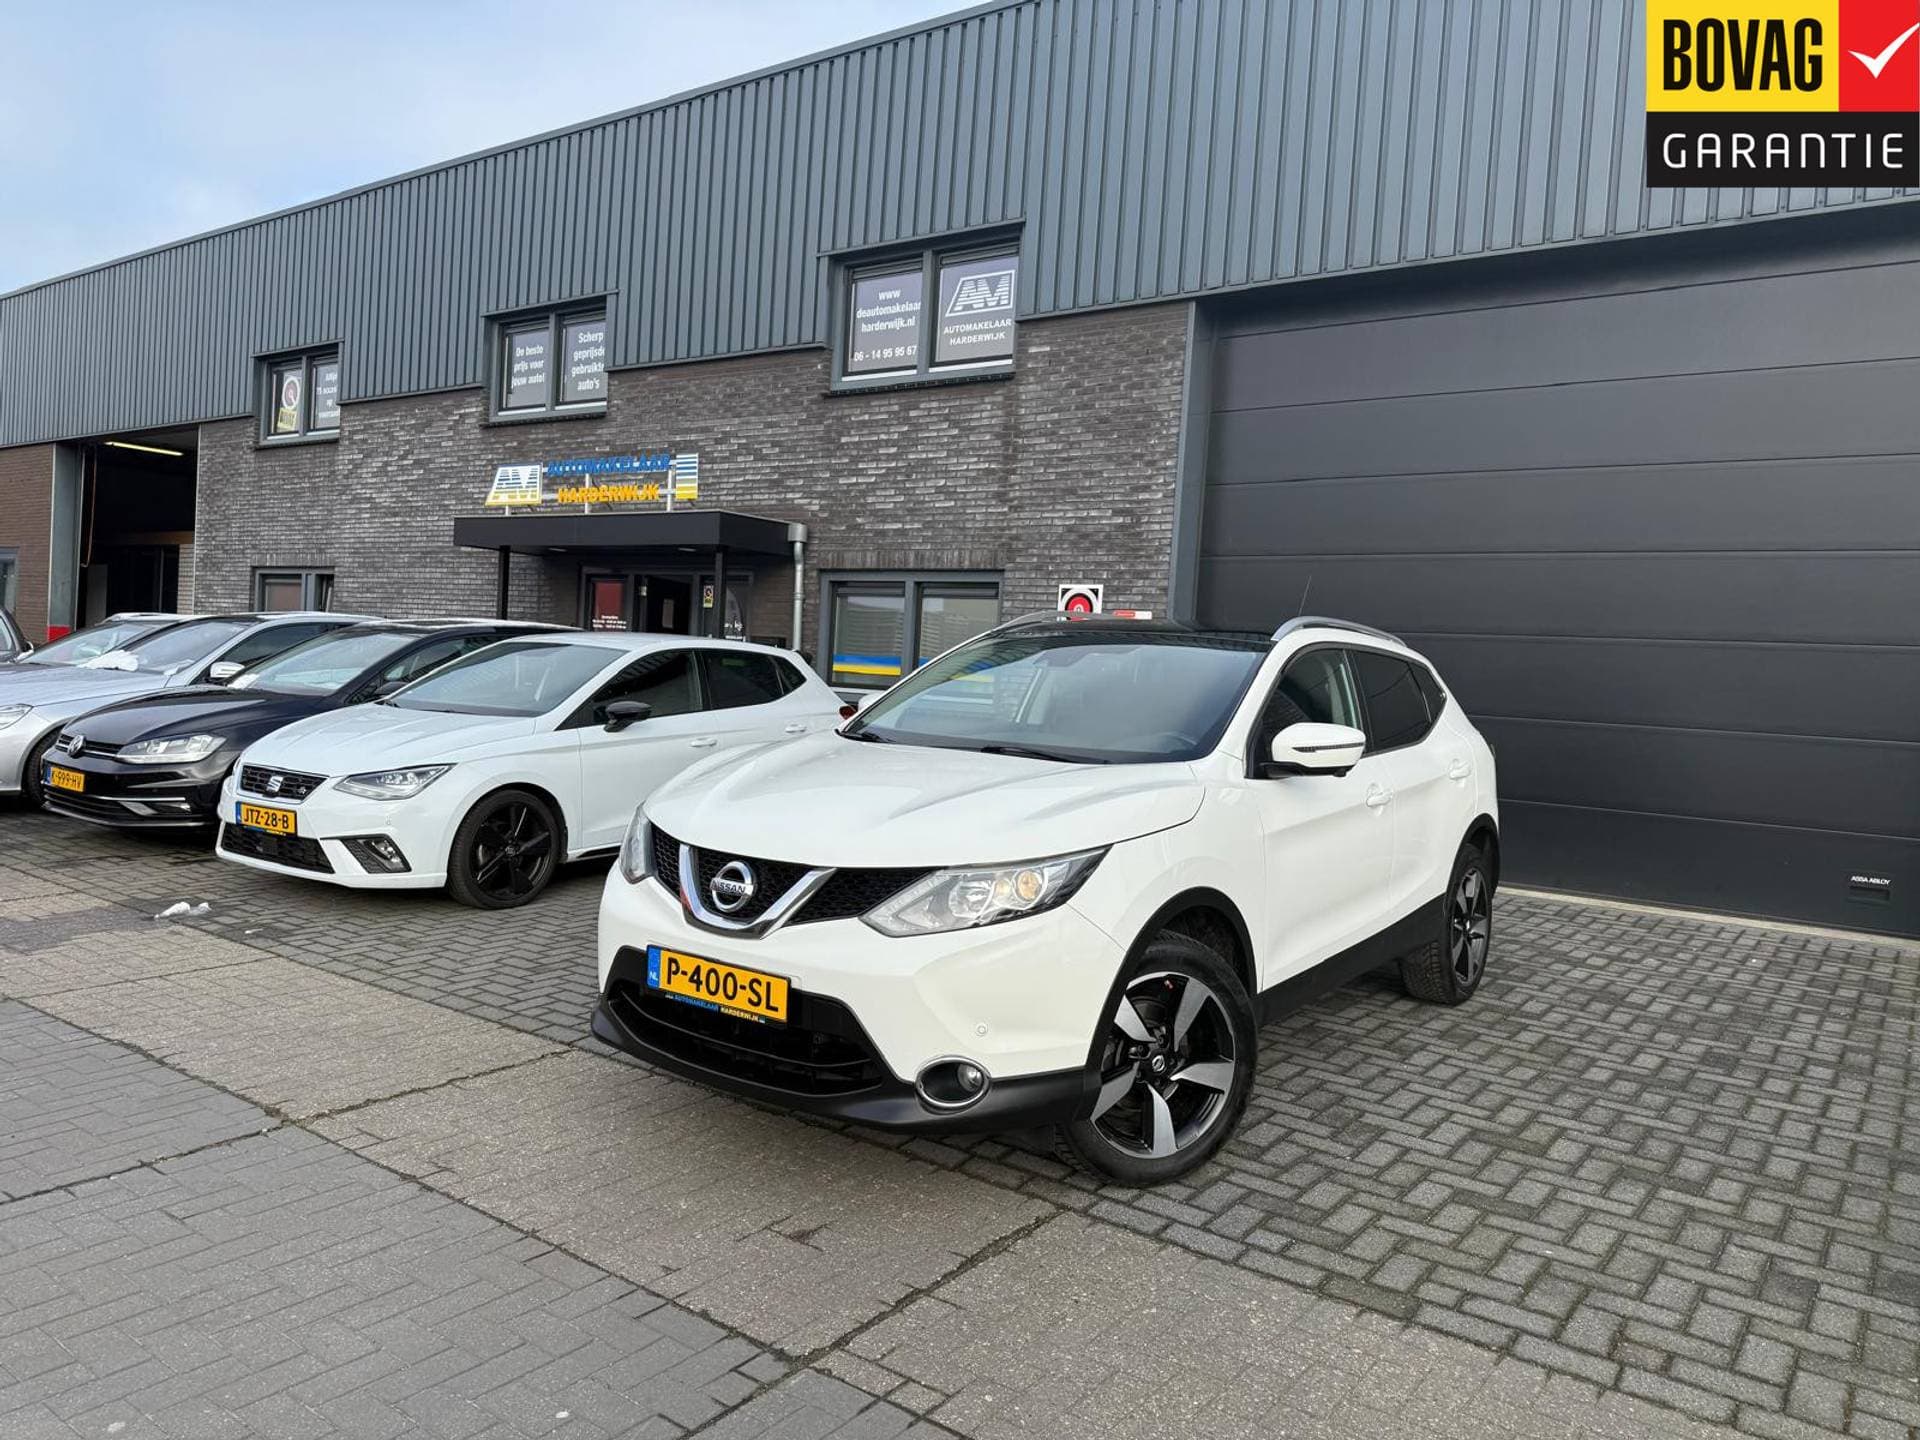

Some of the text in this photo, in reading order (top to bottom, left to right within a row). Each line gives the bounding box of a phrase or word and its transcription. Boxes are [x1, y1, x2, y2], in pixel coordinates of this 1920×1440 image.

[879, 289, 901, 301] www
[856, 301, 921, 318] deautomakelaar
[861, 316, 916, 332] harderwijk.nl
[943, 318, 1012, 334] AUTOMAKELAAR
[578, 331, 604, 343] Scherp
[950, 331, 1006, 346] HARDERWIJK
[516, 345, 544, 357] De beste
[854, 351, 864, 362] 06
[872, 349, 881, 360] 14
[882, 347, 893, 359] 95
[513, 360, 544, 374] prijs voor
[577, 378, 600, 391] auto's
[548, 454, 671, 476] AUTOMAKELAAR
[558, 483, 660, 504] HARDERWIJK
[244, 807, 290, 830] JTZ-28-B
[711, 880, 747, 894] NISSAN
[650, 971, 659, 982] NL
[667, 957, 779, 1013] P-400-SL
[673, 994, 760, 1022] AUTOMAKELAAR HARDERWIJK
